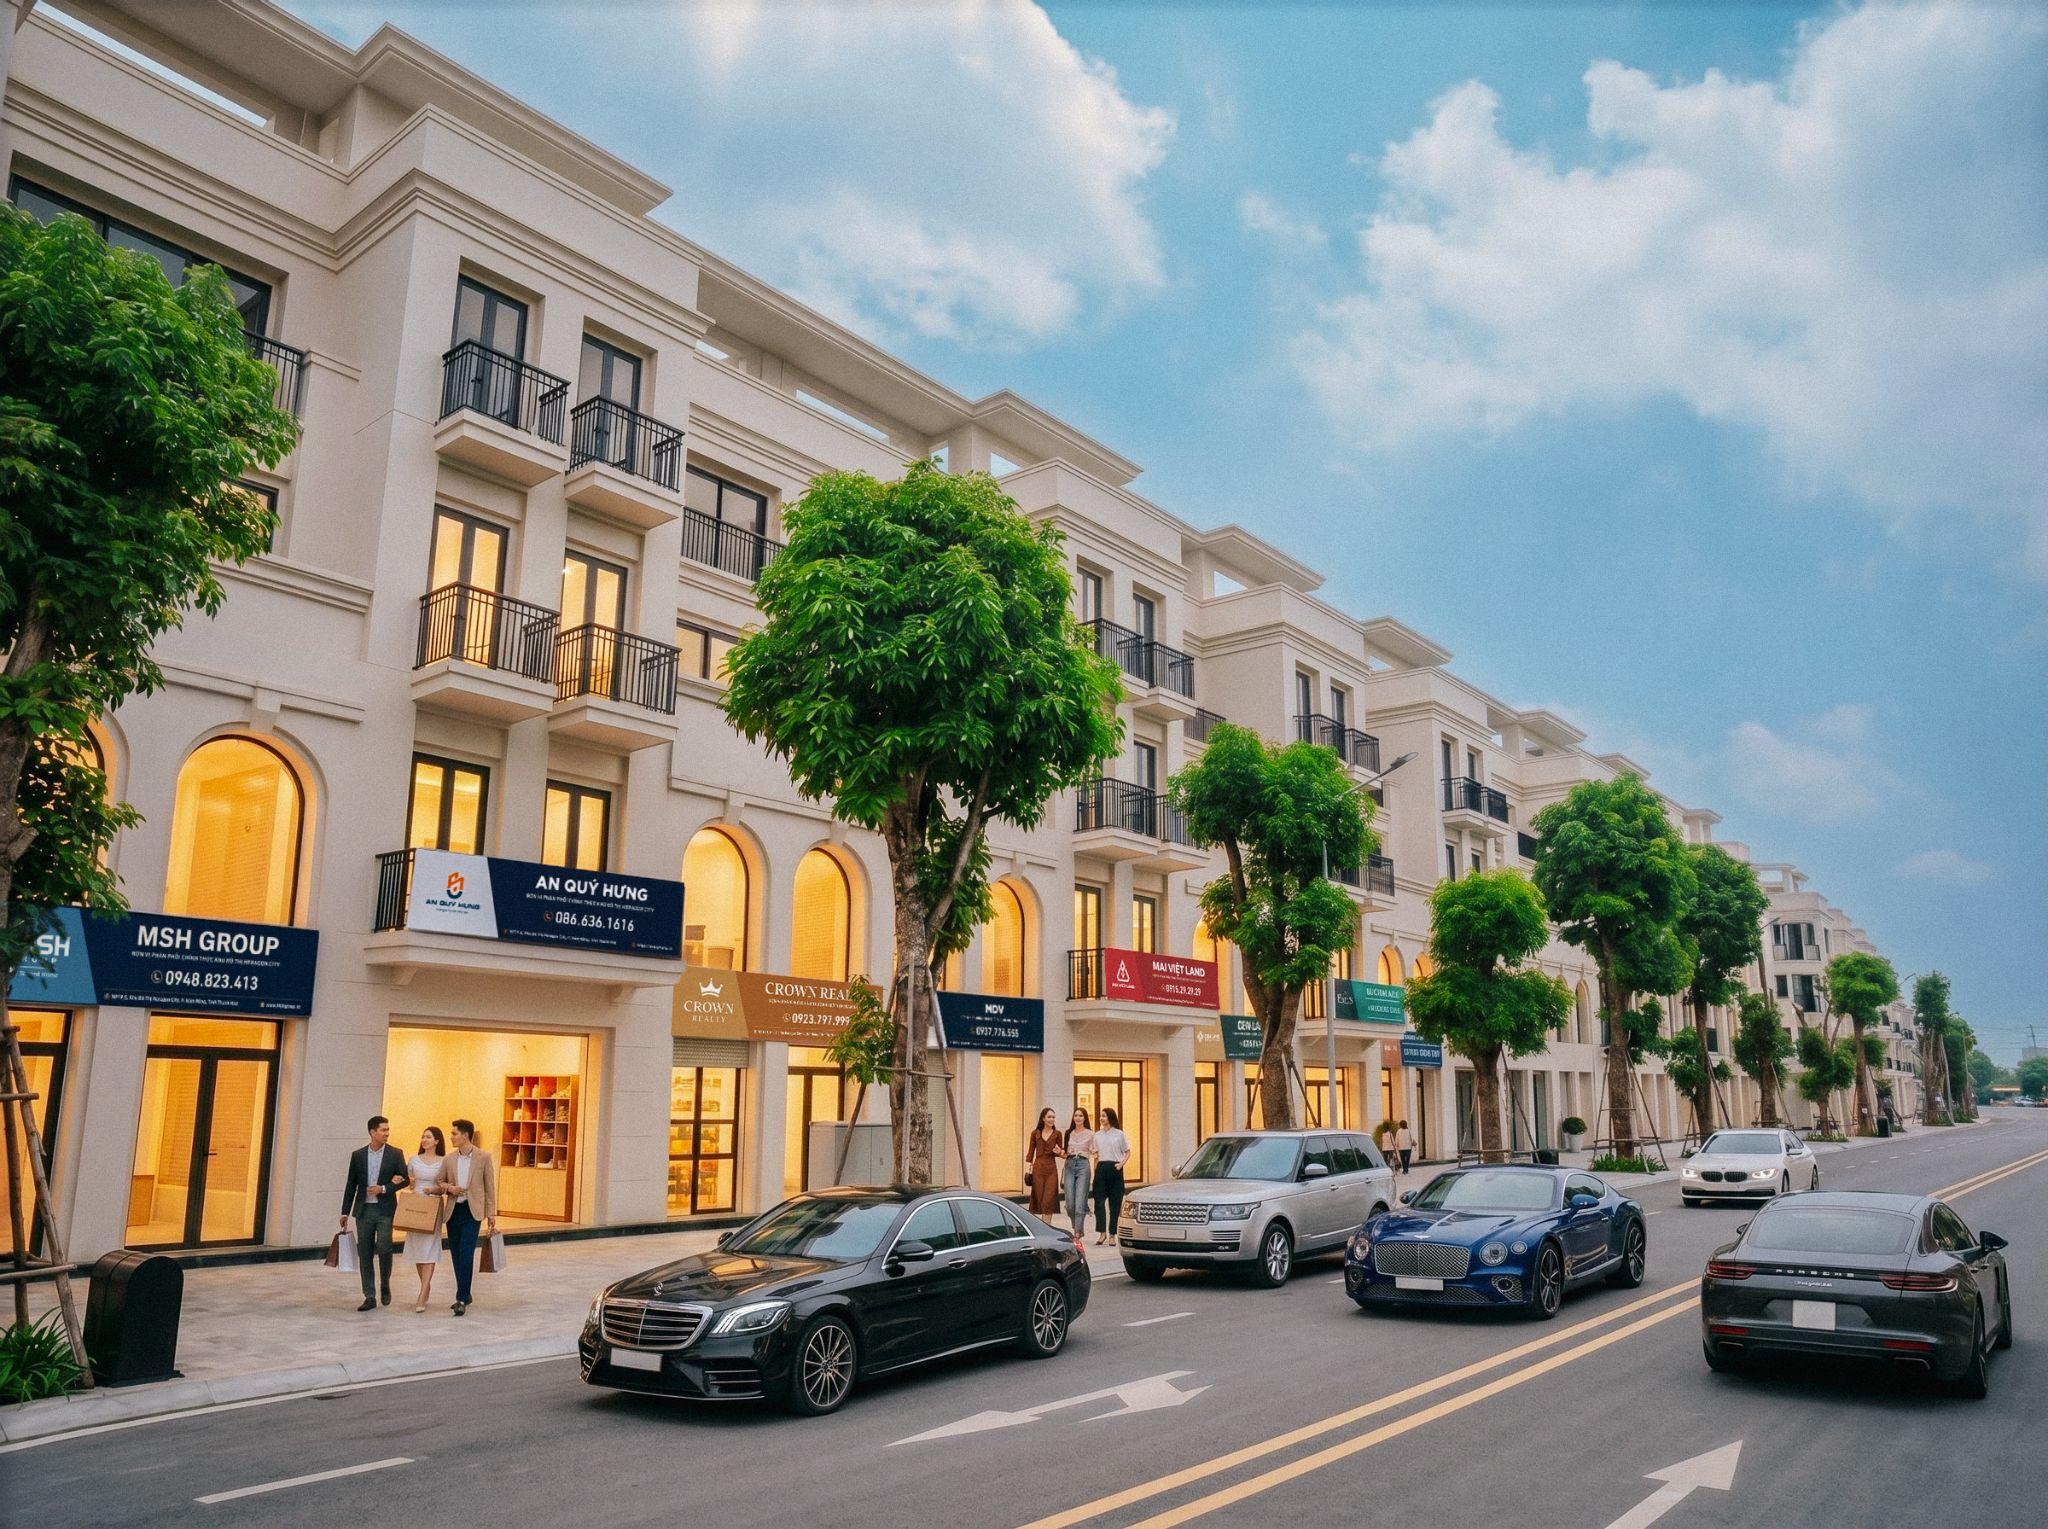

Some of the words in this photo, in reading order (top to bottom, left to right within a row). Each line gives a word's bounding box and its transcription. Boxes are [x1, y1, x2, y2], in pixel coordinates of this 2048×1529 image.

[535, 875, 560, 891] AN
[564, 879, 599, 896] QUÝ
[602, 883, 648, 901] HƯNG
[555, 911, 634, 932] 086.636.1616
[35, 934, 71, 957] SH
[137, 924, 192, 949] MSH
[199, 931, 279, 956] GROUP
[1152, 961, 1168, 972] MAI
[1185, 967, 1206, 978] LAND
[165, 970, 259, 991] 0948.823.413
[764, 981, 818, 999] CROWN
[683, 1000, 734, 1015] CROWN
[984, 1004, 1005, 1015] MDV
[791, 1013, 850, 1026] 0923.797.999
